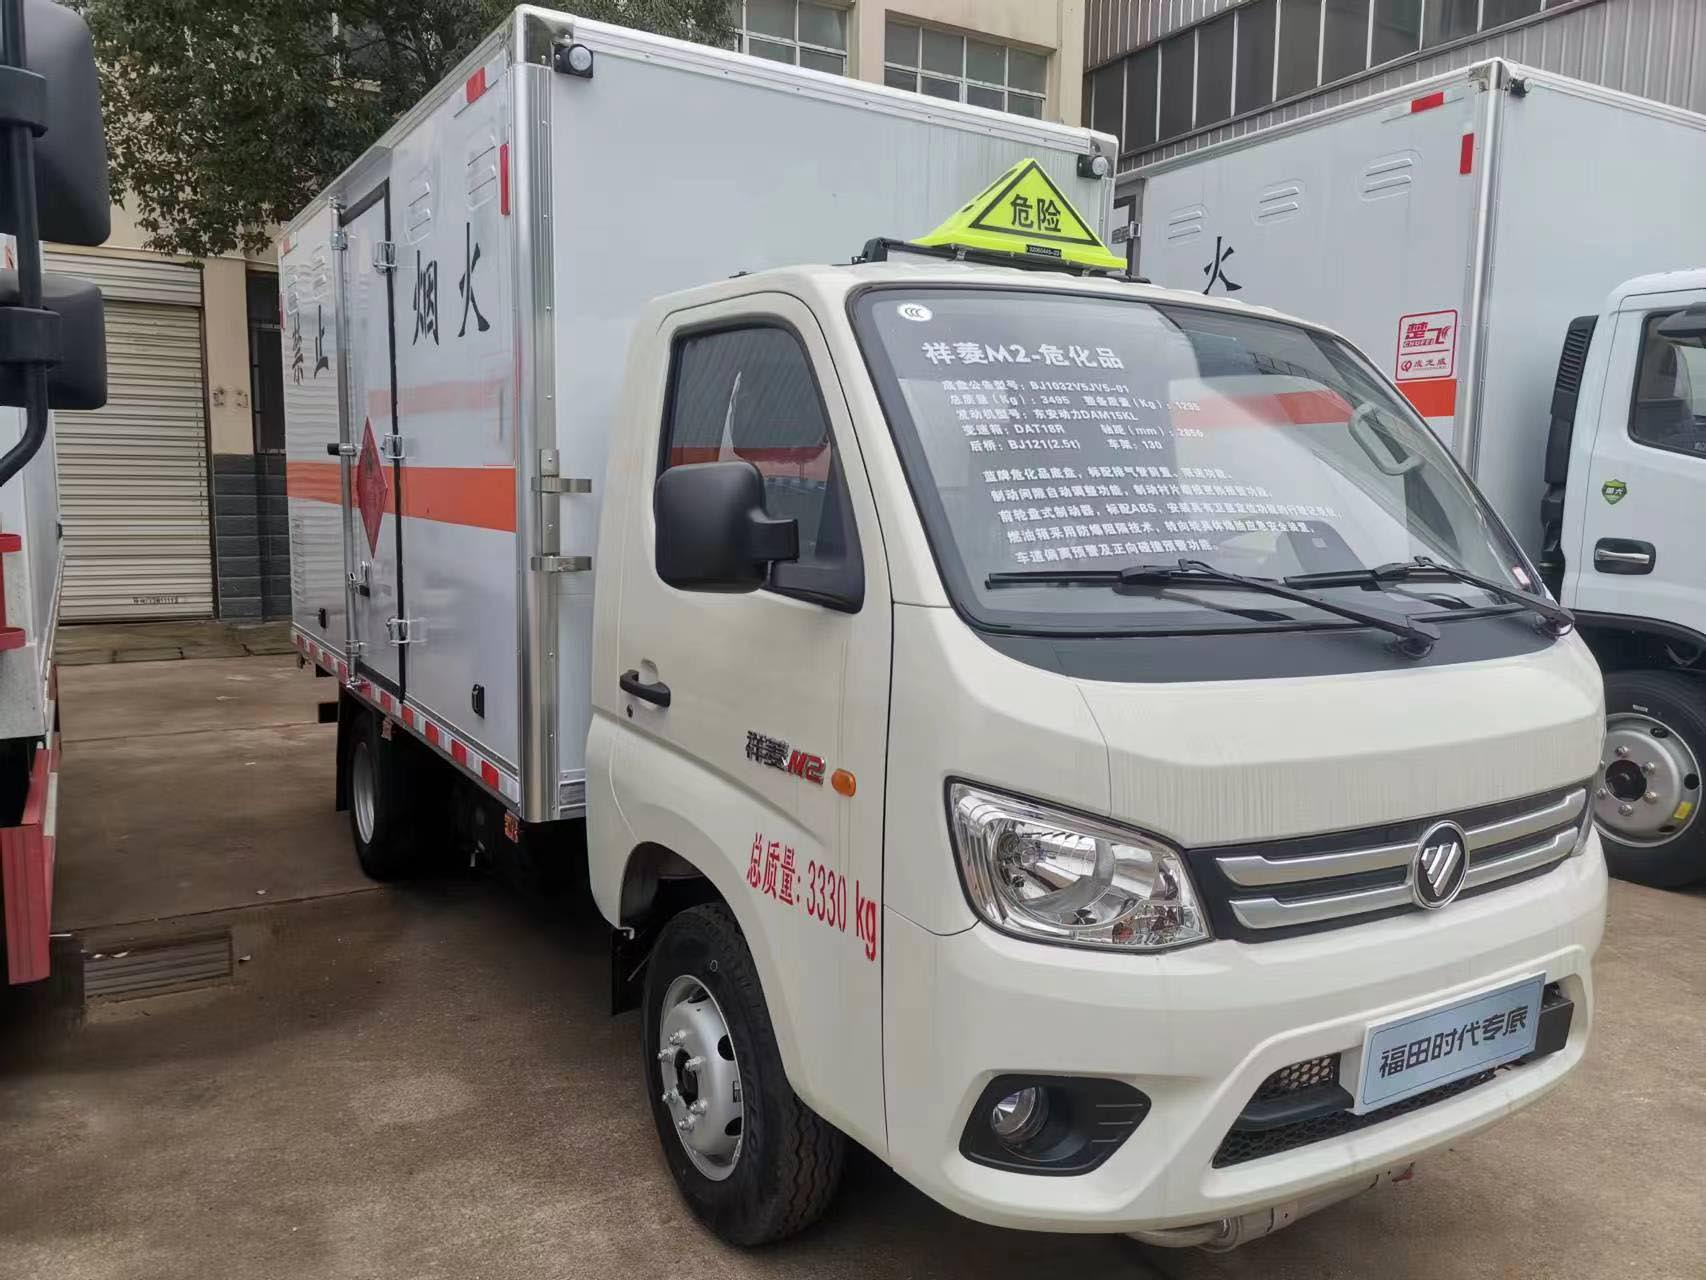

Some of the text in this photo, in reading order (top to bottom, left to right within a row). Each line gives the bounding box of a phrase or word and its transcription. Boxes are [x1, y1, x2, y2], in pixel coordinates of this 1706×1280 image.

[1010, 193, 1062, 232] 危险
[1202, 236, 1242, 295] 火
[922, 342, 1125, 369] 祥菱M2-危化品
[745, 730, 826, 786] 祥菱M2
[856, 880, 877, 961] kg
[1379, 1005, 1528, 1078] 福田时代专底
